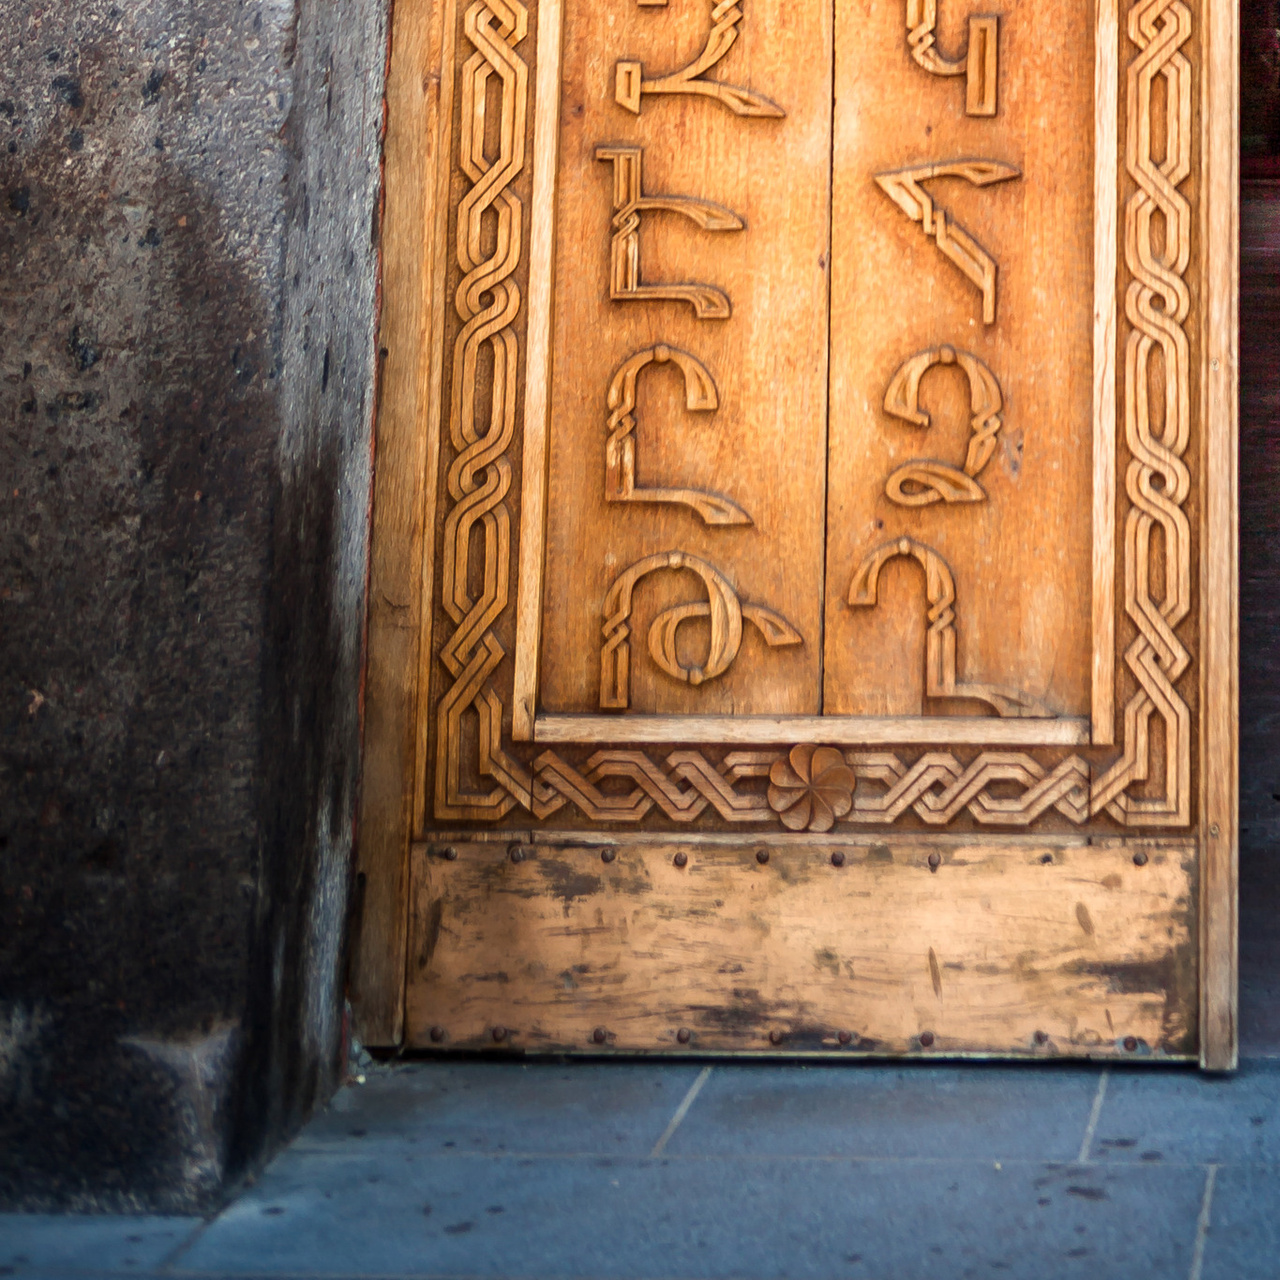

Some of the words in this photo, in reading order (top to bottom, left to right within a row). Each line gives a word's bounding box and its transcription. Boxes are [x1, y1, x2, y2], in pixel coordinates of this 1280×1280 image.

[594, 146, 747, 320] Է
[873, 159, 1022, 326] Հ
[604, 342, 753, 527] Ը
